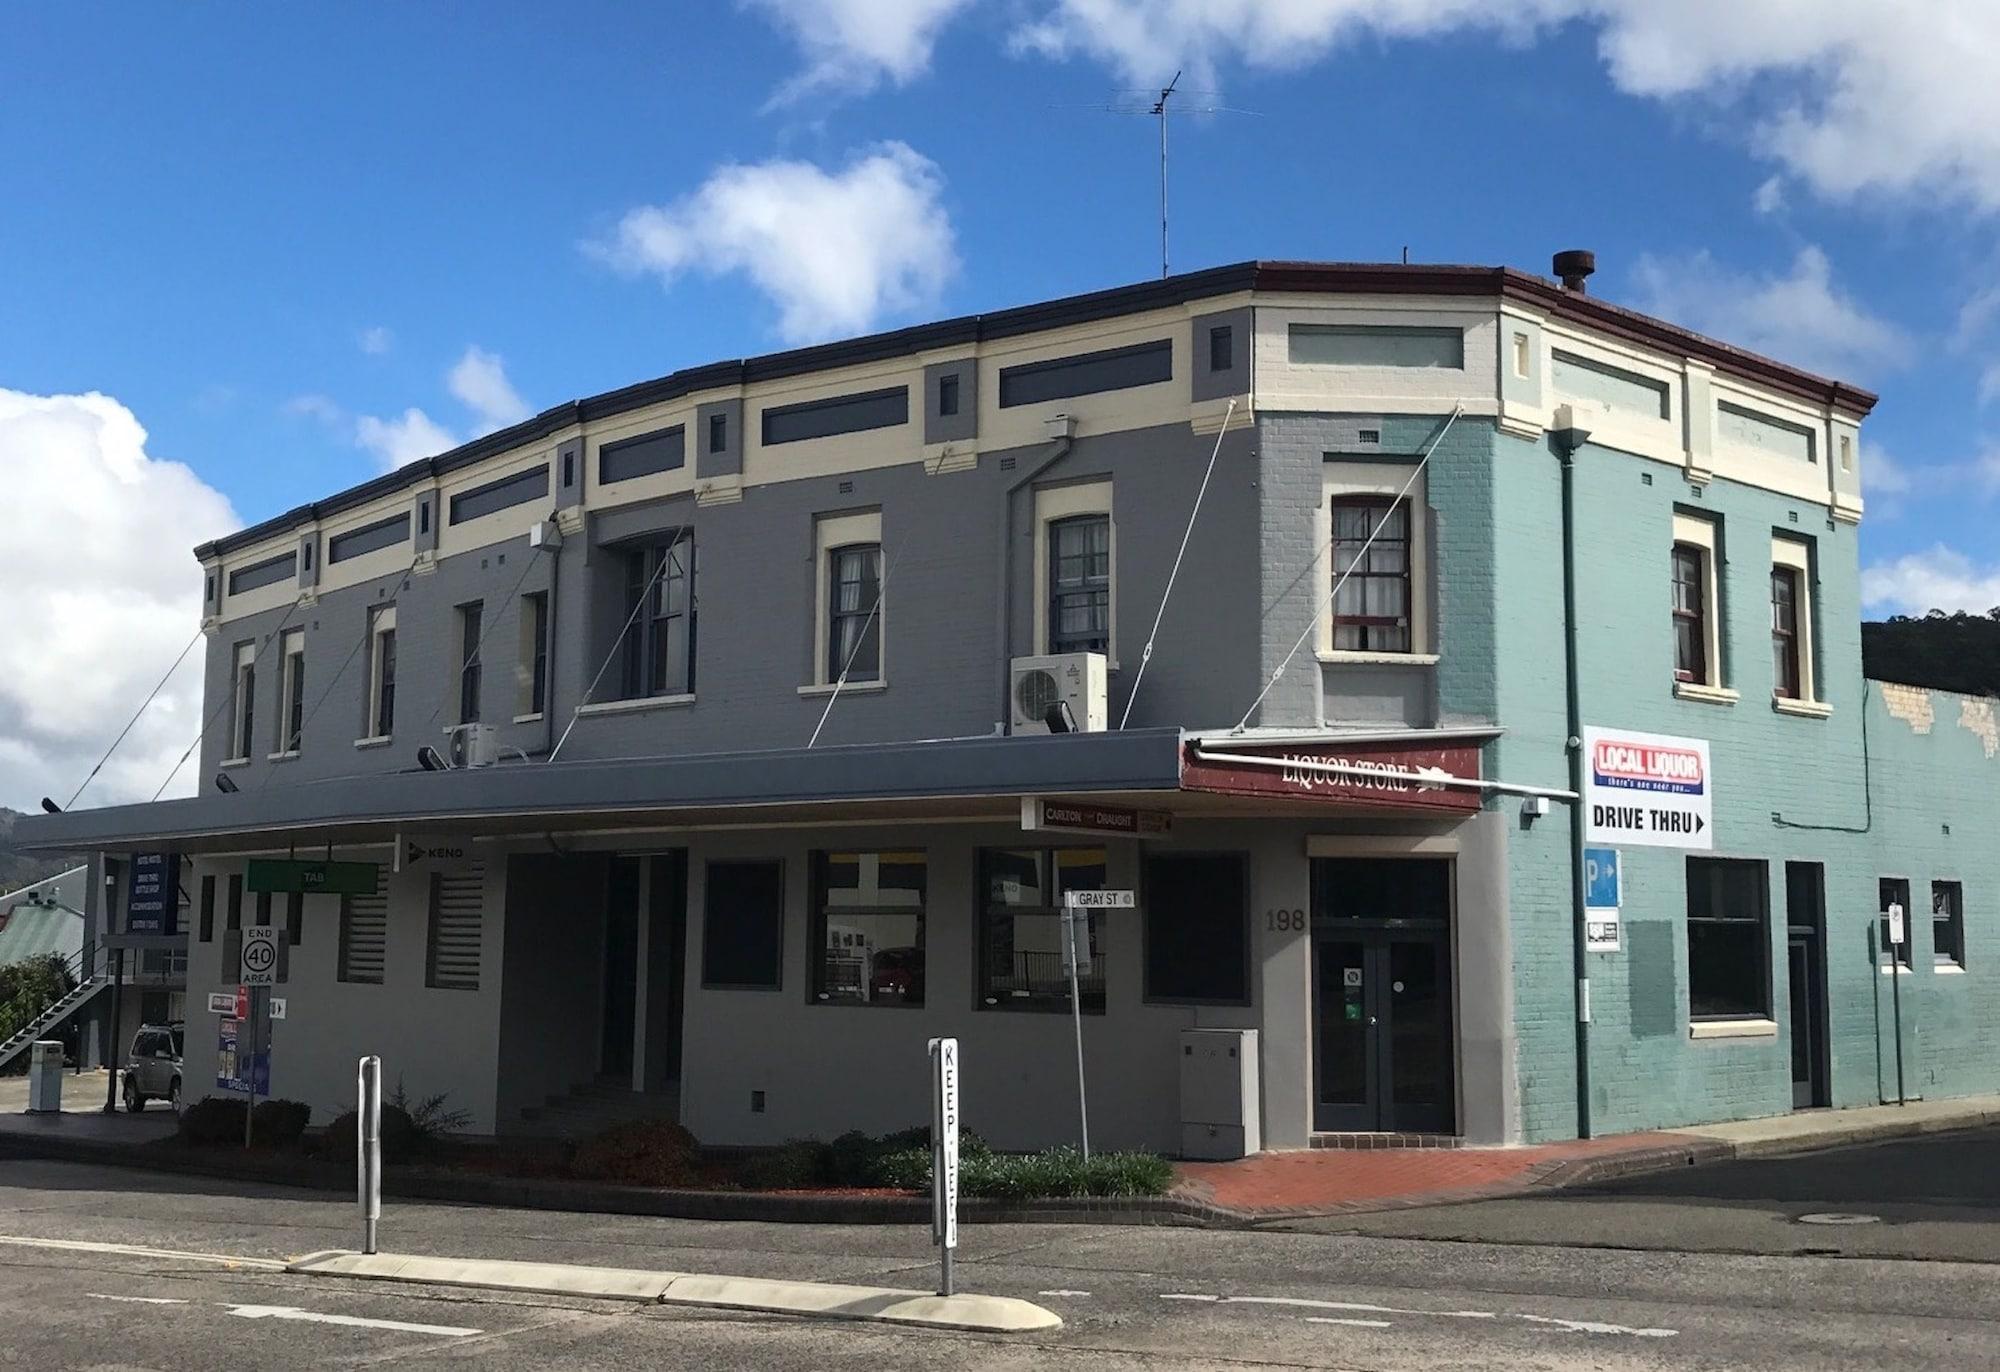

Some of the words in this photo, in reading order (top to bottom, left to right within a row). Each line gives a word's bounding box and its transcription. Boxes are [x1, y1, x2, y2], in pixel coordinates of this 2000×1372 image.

[1598, 745, 1646, 774] LOCAL
[1647, 751, 1698, 779] LIQUOR
[1282, 753, 1352, 789] LIQUOR
[1355, 760, 1409, 792] STORE
[1047, 807, 1082, 823] CARLTON
[1096, 812, 1131, 826] DRAUGHT
[1594, 805, 1643, 830] DRIVE
[1650, 809, 1691, 833] THRU
[429, 848, 463, 858] KENO
[303, 872, 325, 882] TAB
[1586, 859, 1598, 897] P
[1079, 893, 1103, 905] GRAY
[1106, 893, 1118, 905] ST
[1266, 909, 1305, 931] 198
[248, 929, 272, 938] END
[248, 947, 271, 964] 40
[243, 974, 273, 983] AREA
[945, 1045, 955, 1134] KEEP
